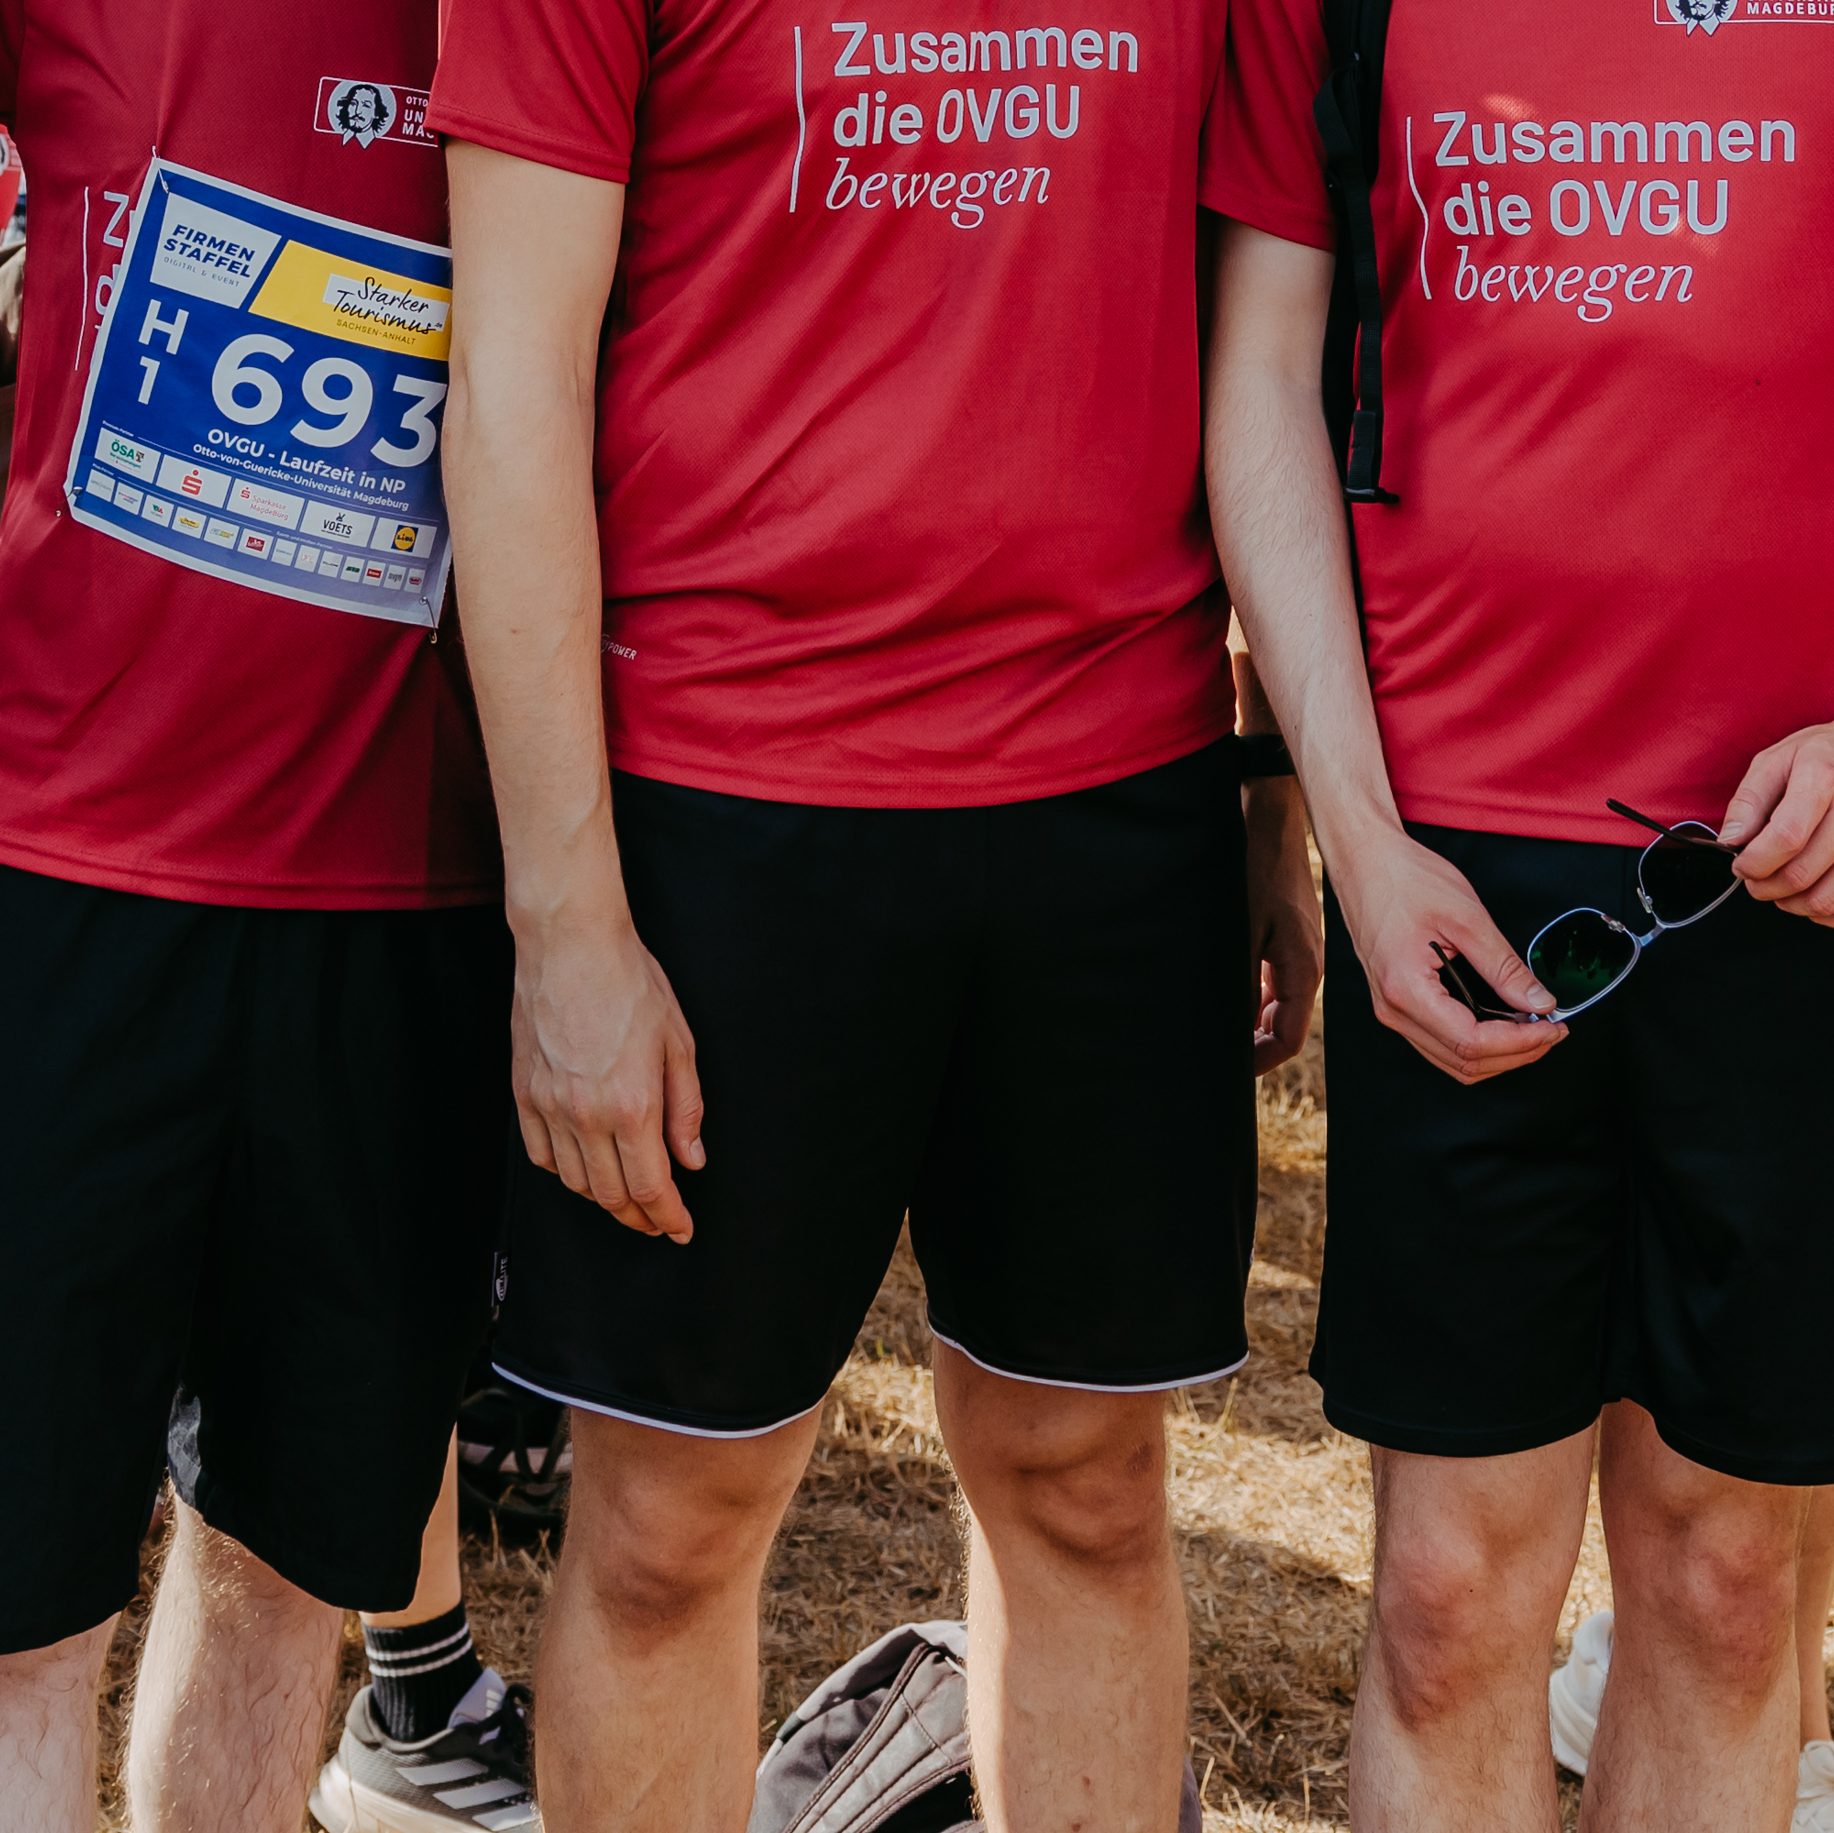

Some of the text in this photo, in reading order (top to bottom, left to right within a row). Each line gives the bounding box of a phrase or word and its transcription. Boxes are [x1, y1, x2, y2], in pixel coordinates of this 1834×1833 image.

[831, 21, 1139, 76] Zusammen
[405, 95, 429, 107] OTTO
[833, 83, 1081, 147] die OVGU
[1433, 110, 1796, 168] Zusammen
[825, 157, 1051, 230] bewegen
[1443, 179, 1730, 237] die OVGU
[163, 238, 252, 278] STAFFEL
[172, 224, 256, 262] FIRMEN
[211, 273, 240, 287] EVENT
[357, 276, 429, 314] Starker
[1453, 246, 1694, 324] bewegen
[138, 298, 190, 355] H
[333, 289, 437, 335] Tourismus
[336, 318, 417, 345] SACHSEN-ANHALT
[137, 355, 161, 405] 1
[211, 333, 447, 468] 693
[111, 438, 135, 461] ÖSA
[207, 428, 265, 458] OVGU
[280, 450, 356, 485] Laufzeit
[359, 471, 376, 490] in
[380, 476, 406, 494] NP
[193, 443, 410, 511] Otto-von-Guericke-Universität Magdeburg
[251, 494, 287, 511] Sparkasse
[323, 519, 353, 536] VOETS
